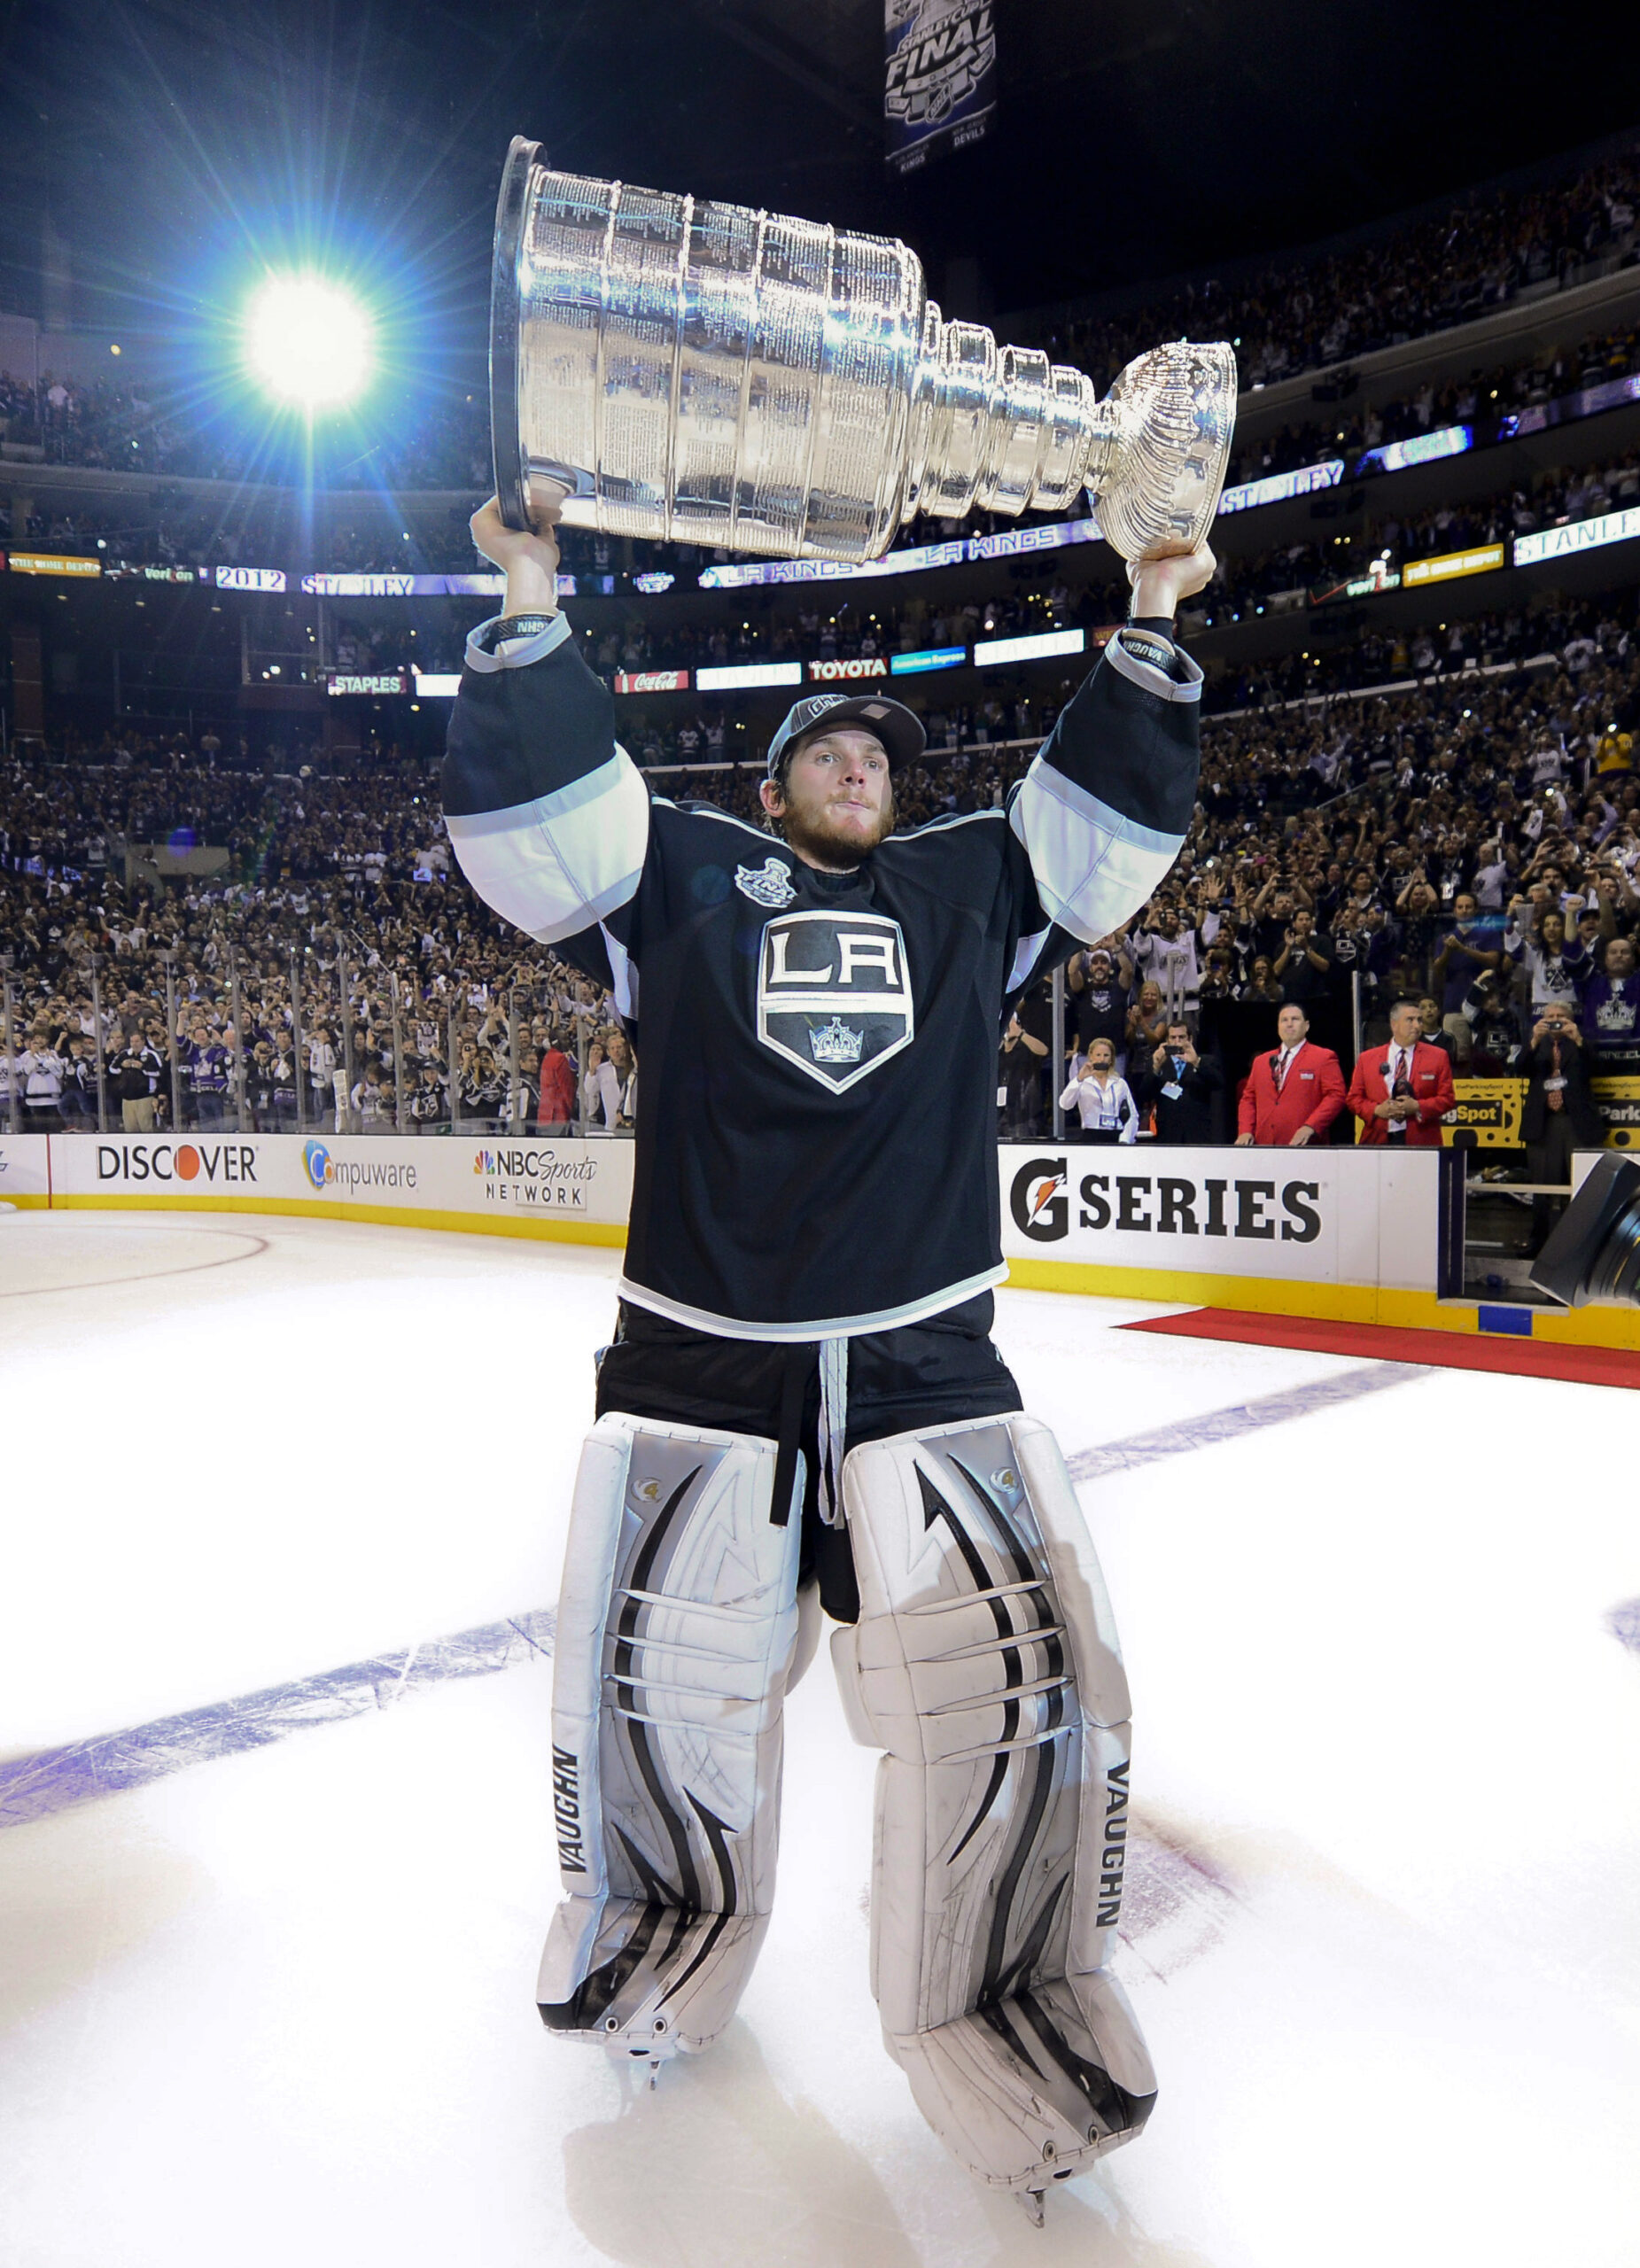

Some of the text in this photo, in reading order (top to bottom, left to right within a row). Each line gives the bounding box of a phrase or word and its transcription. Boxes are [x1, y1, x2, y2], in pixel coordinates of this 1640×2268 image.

[886, 8, 994, 90] FINAL
[899, 16, 951, 53] STANLEY
[916, 56, 962, 88] 2012
[953, 124, 985, 147] DEVILS
[900, 153, 926, 174] KINGS
[924, 528, 1055, 564] LA KINGS
[218, 568, 283, 588] 2012
[727, 562, 853, 583] LA KINGS
[335, 676, 402, 695] STAPLES
[810, 658, 888, 680] TOYOTA
[769, 931, 899, 985] LA
[97, 1144, 258, 1181] DISCOVER
[310, 1148, 417, 1195] Compuware
[496, 1150, 598, 1185] NBC Sports
[486, 1183, 582, 1206] NETWORK
[1010, 1157, 1323, 1244] G SERIES
[552, 1742, 587, 1873] VAUGHN
[1096, 1758, 1131, 1928] VAUGHN
